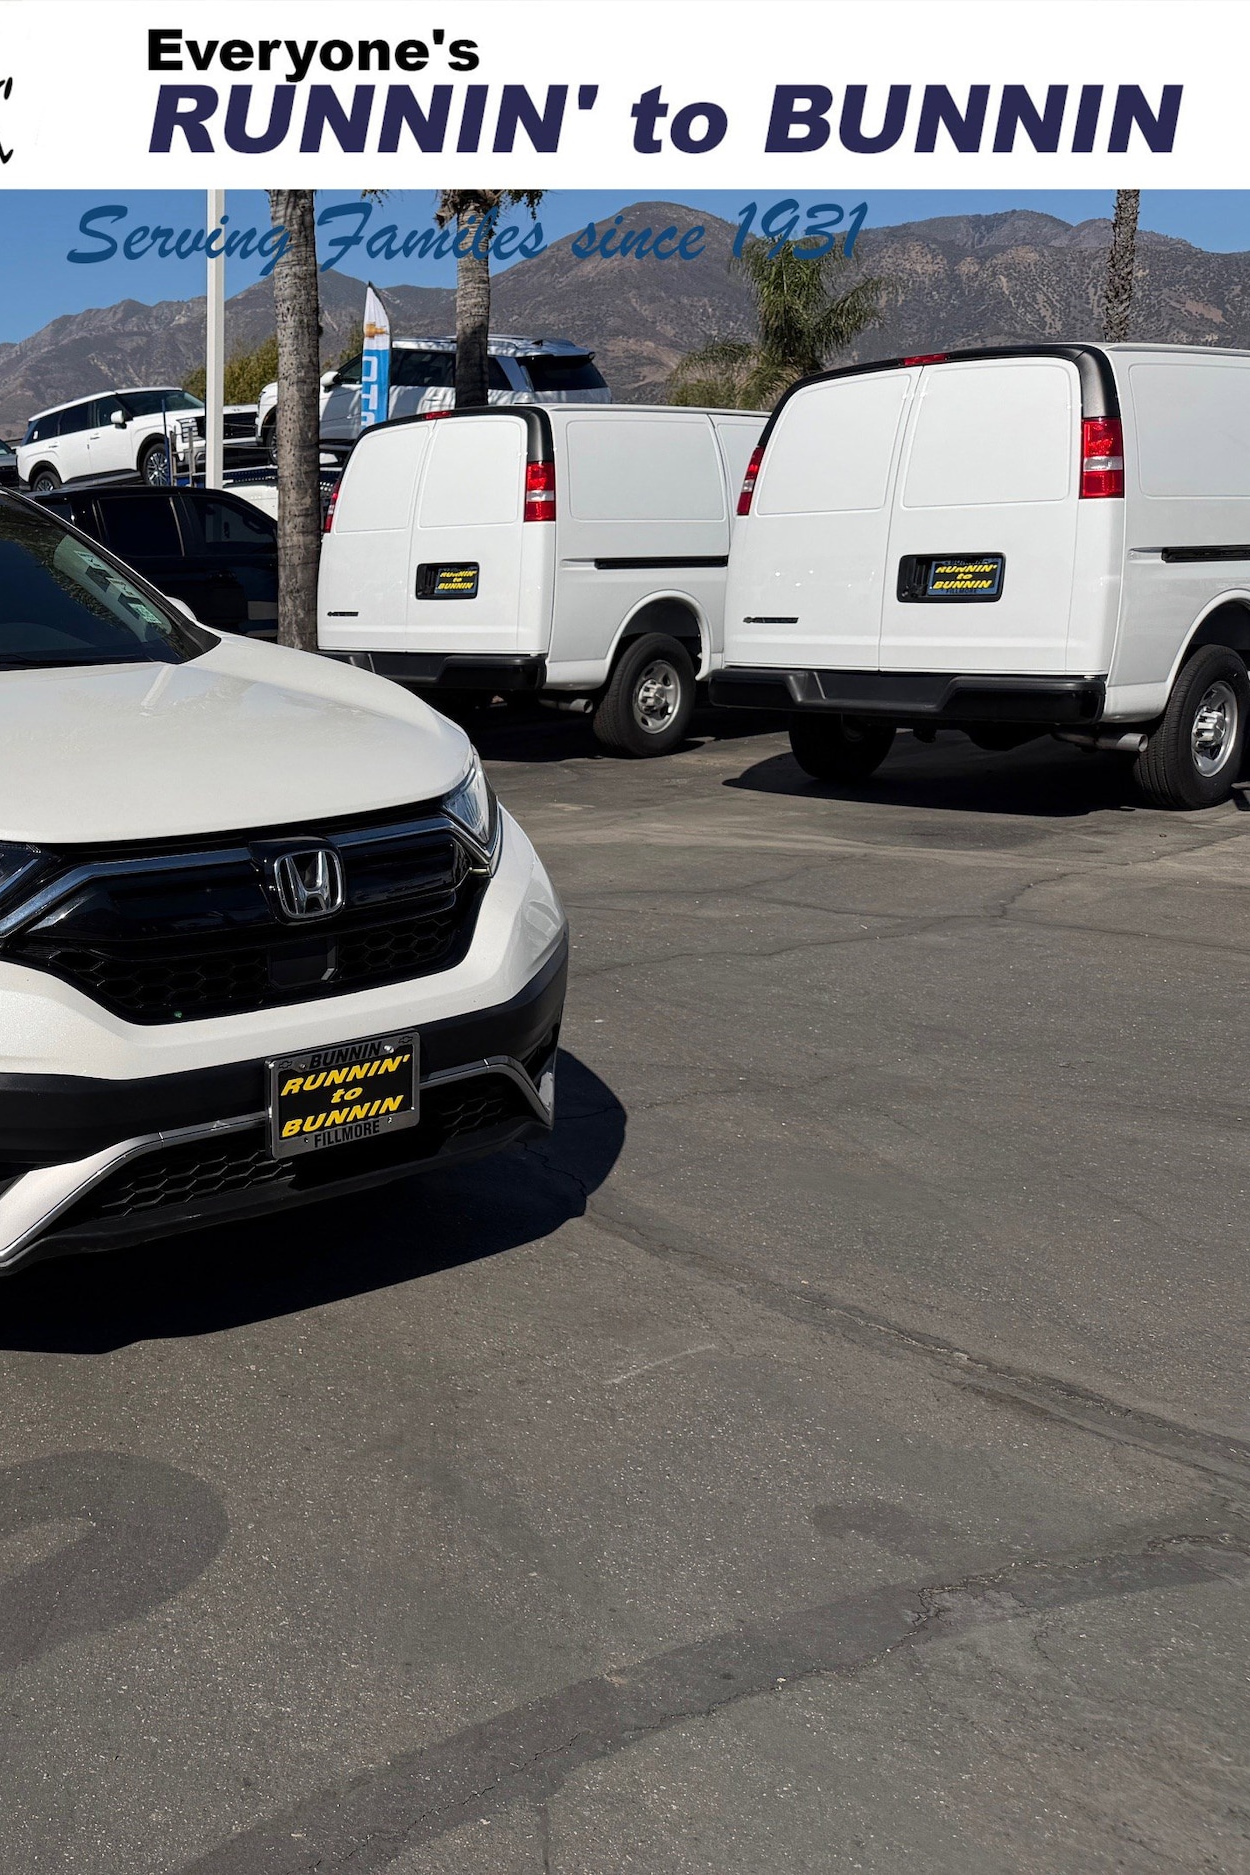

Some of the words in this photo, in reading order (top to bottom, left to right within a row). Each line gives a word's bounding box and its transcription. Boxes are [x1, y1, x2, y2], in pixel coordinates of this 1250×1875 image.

[932, 580, 993, 589] BUNNIN
[309, 1041, 383, 1069] BUNNIN
[280, 1053, 411, 1097] RUNNIN'
[331, 1086, 364, 1104] to
[281, 1094, 405, 1138] BUNNIN
[313, 1119, 381, 1149] FILLMORE
